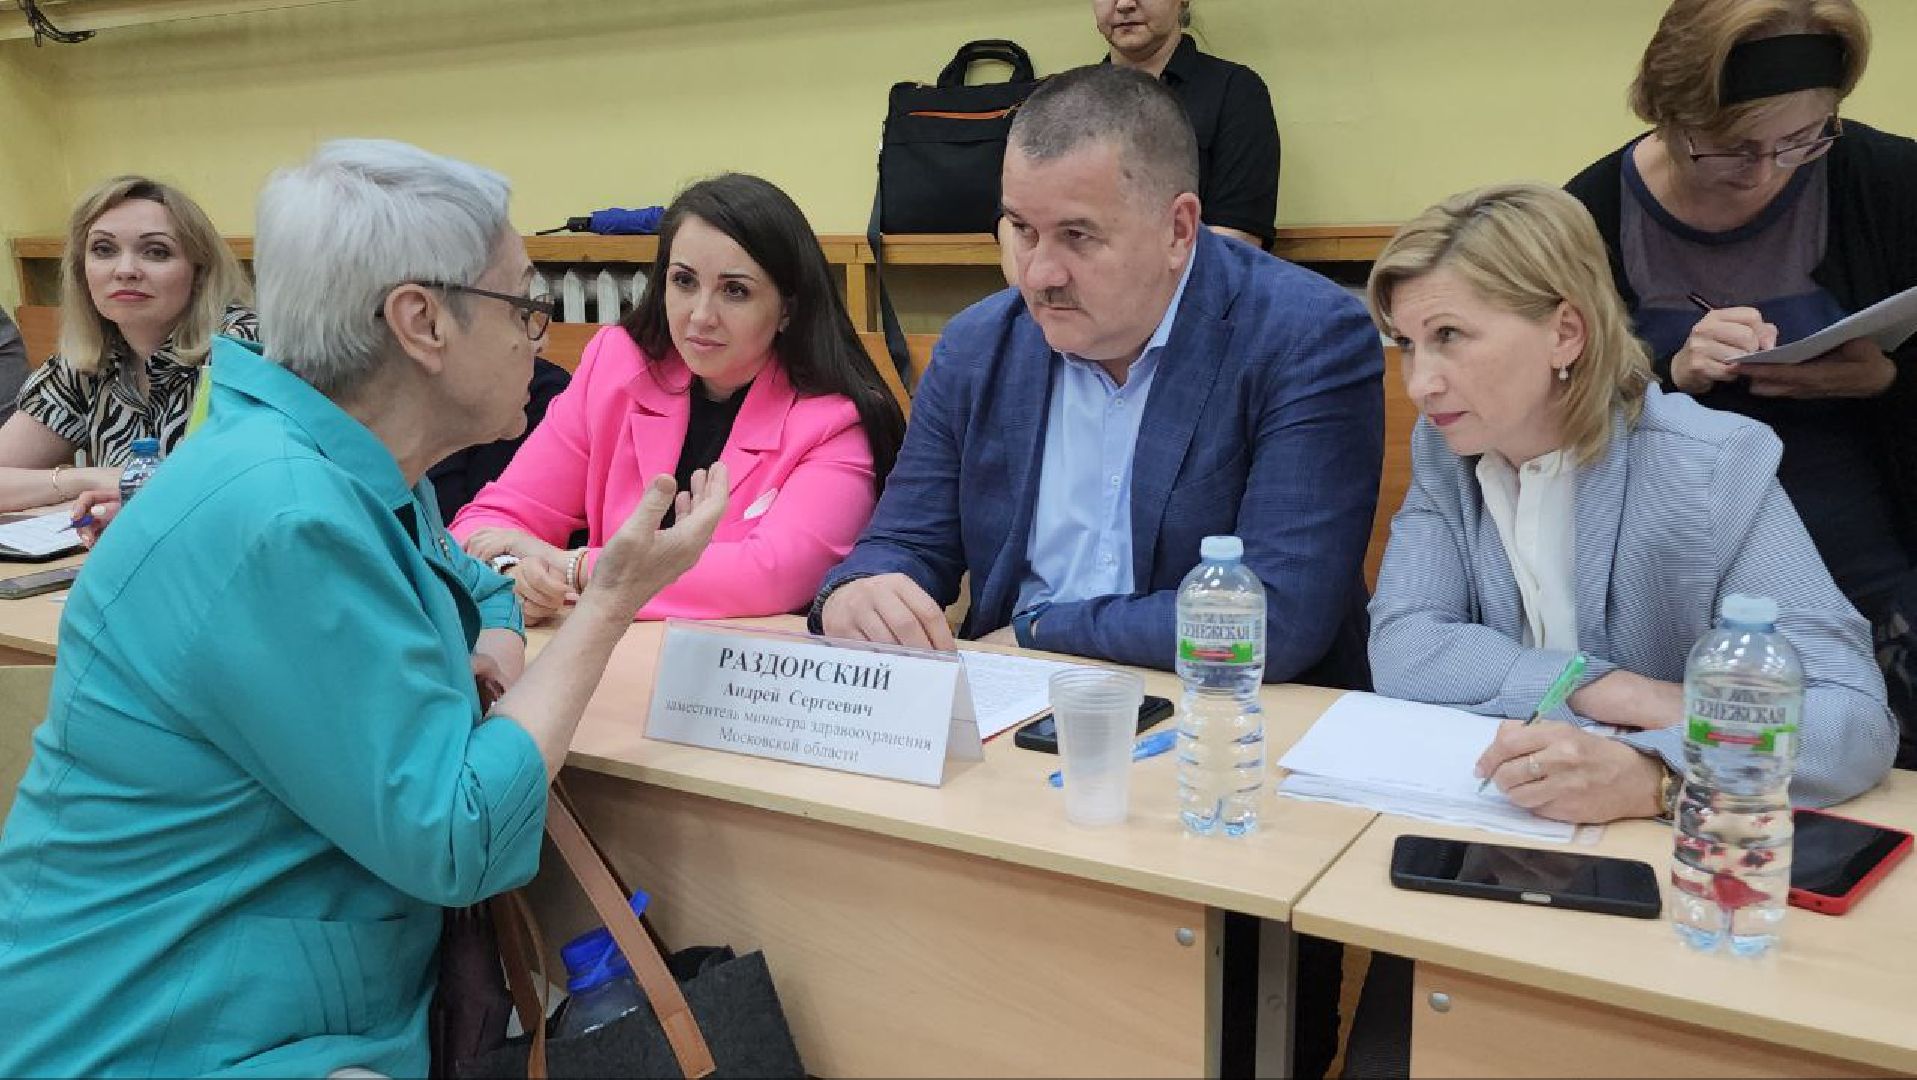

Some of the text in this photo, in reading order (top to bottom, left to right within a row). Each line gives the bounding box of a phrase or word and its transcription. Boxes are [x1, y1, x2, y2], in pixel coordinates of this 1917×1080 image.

[719, 647, 892, 691] РАЗДОРСКИЙ
[722, 682, 873, 717] Андрей Сергеевич
[665, 699, 932, 750] заместитель министра здравоохранения
[719, 727, 859, 762] Московской области
